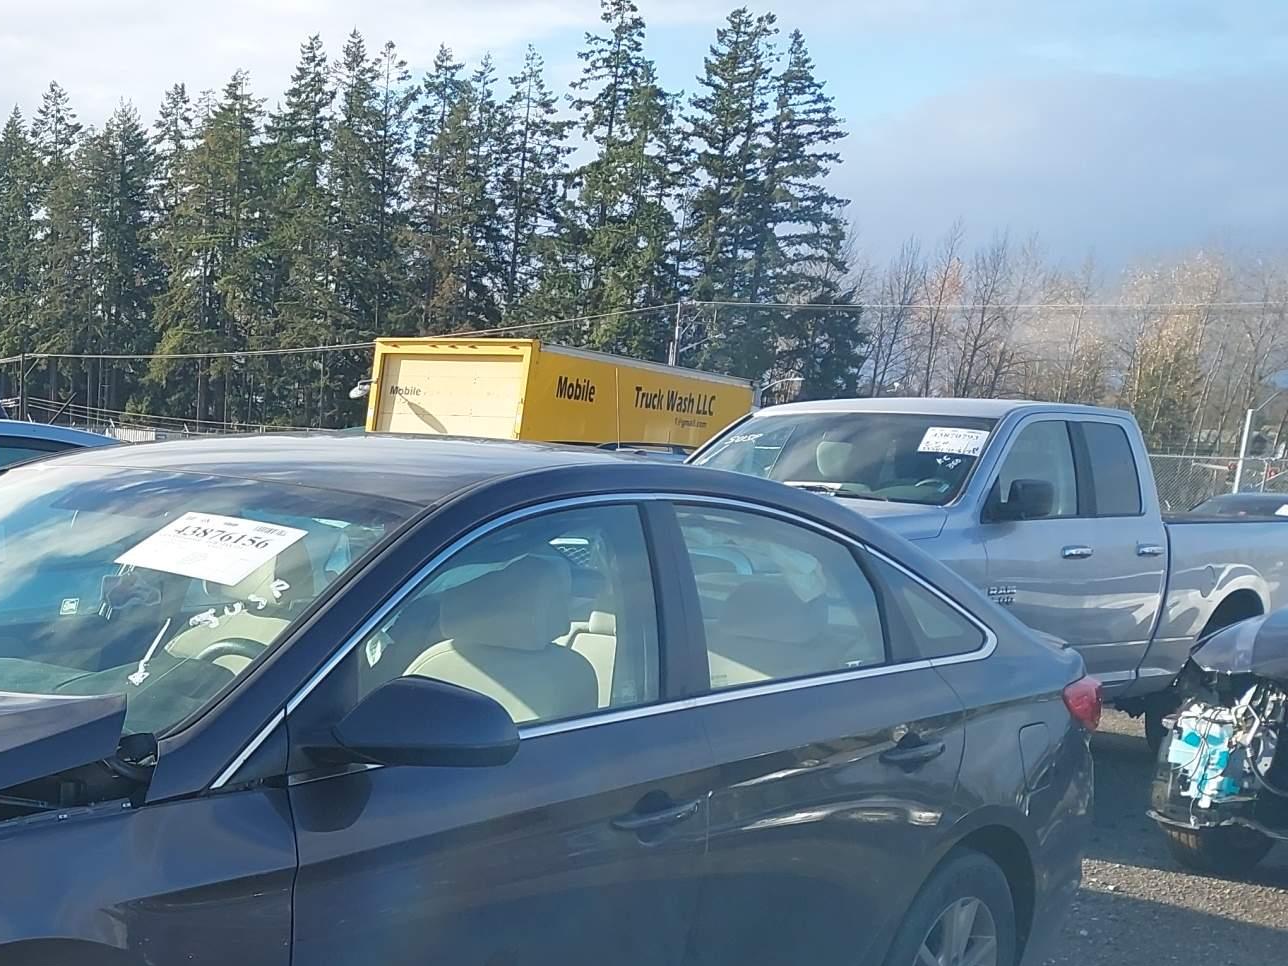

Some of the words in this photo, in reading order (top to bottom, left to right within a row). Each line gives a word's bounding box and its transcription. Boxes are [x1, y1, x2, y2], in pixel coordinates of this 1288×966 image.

[390, 385, 422, 396] Mobile
[556, 376, 596, 402] Mobile
[634, 386, 664, 410] Truck
[666, 389, 695, 414] Wash
[696, 394, 716, 416] LLC
[175, 526, 272, 549] 43876156
